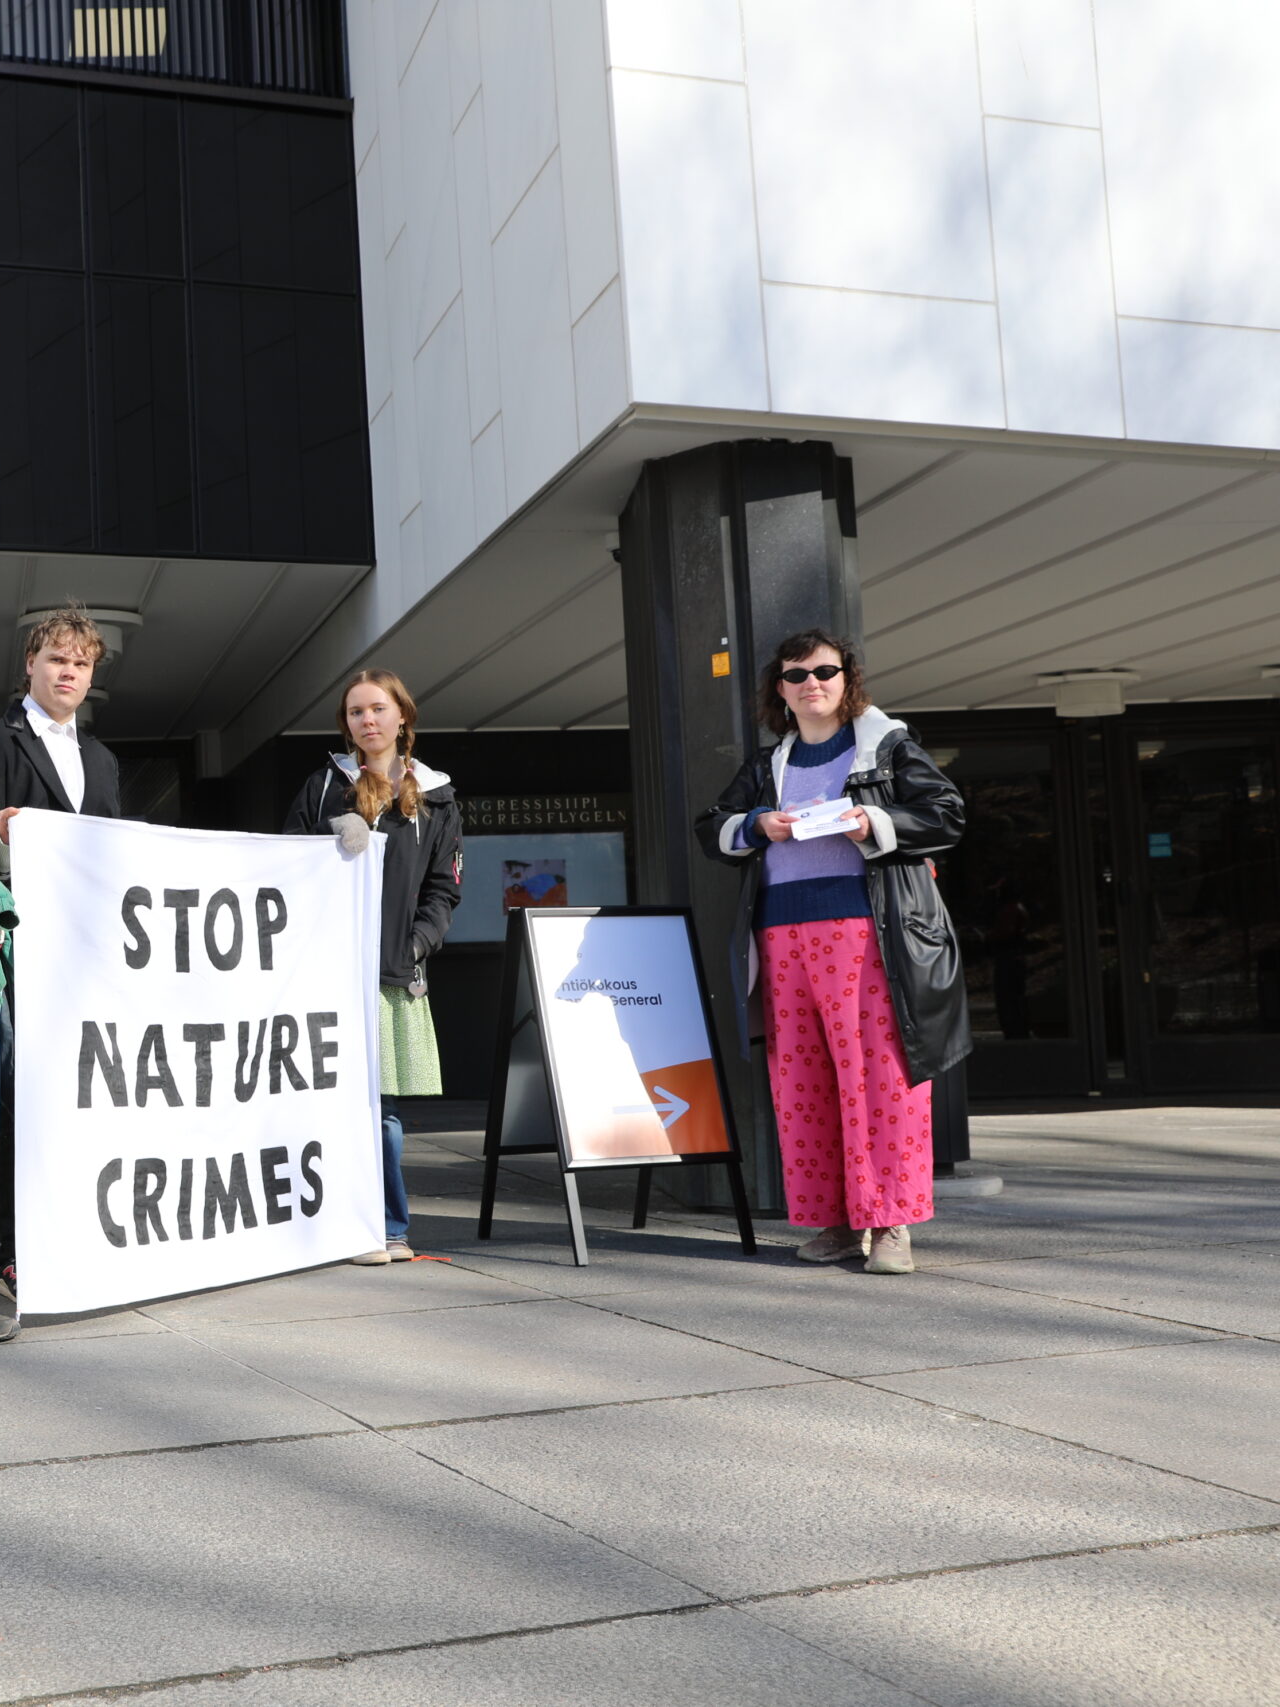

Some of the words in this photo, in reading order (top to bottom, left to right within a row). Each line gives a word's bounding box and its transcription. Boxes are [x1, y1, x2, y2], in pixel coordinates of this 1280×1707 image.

[455, 797, 597, 812] ONGRESSISIIPI
[122, 886, 287, 973] STOP
[78, 1012, 338, 1109] NATURE
[96, 1141, 323, 1248] CRIMES
